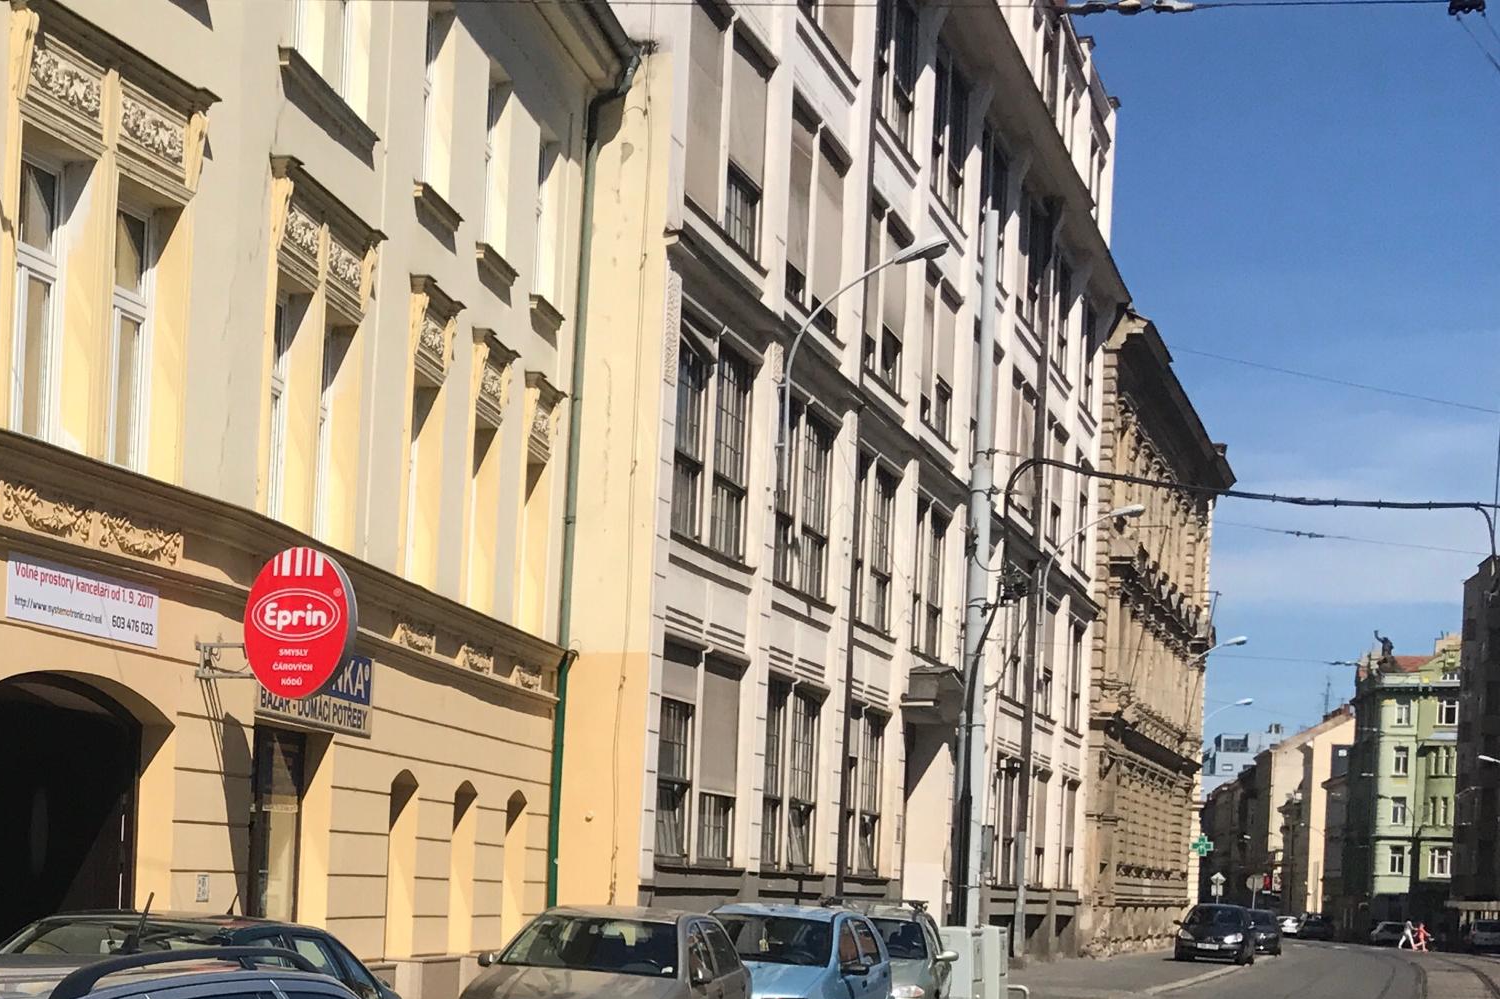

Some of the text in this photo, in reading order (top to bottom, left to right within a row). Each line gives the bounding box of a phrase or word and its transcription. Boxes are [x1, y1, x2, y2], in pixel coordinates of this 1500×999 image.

[40, 571, 74, 594] prostory
[111, 588, 120, 601] od
[137, 593, 154, 609] 2017
[112, 615, 154, 636] 603 476 032
[263, 600, 327, 631] Eprin
[278, 648, 308, 657] SMYSLY
[332, 702, 368, 730] POTŘEBY
